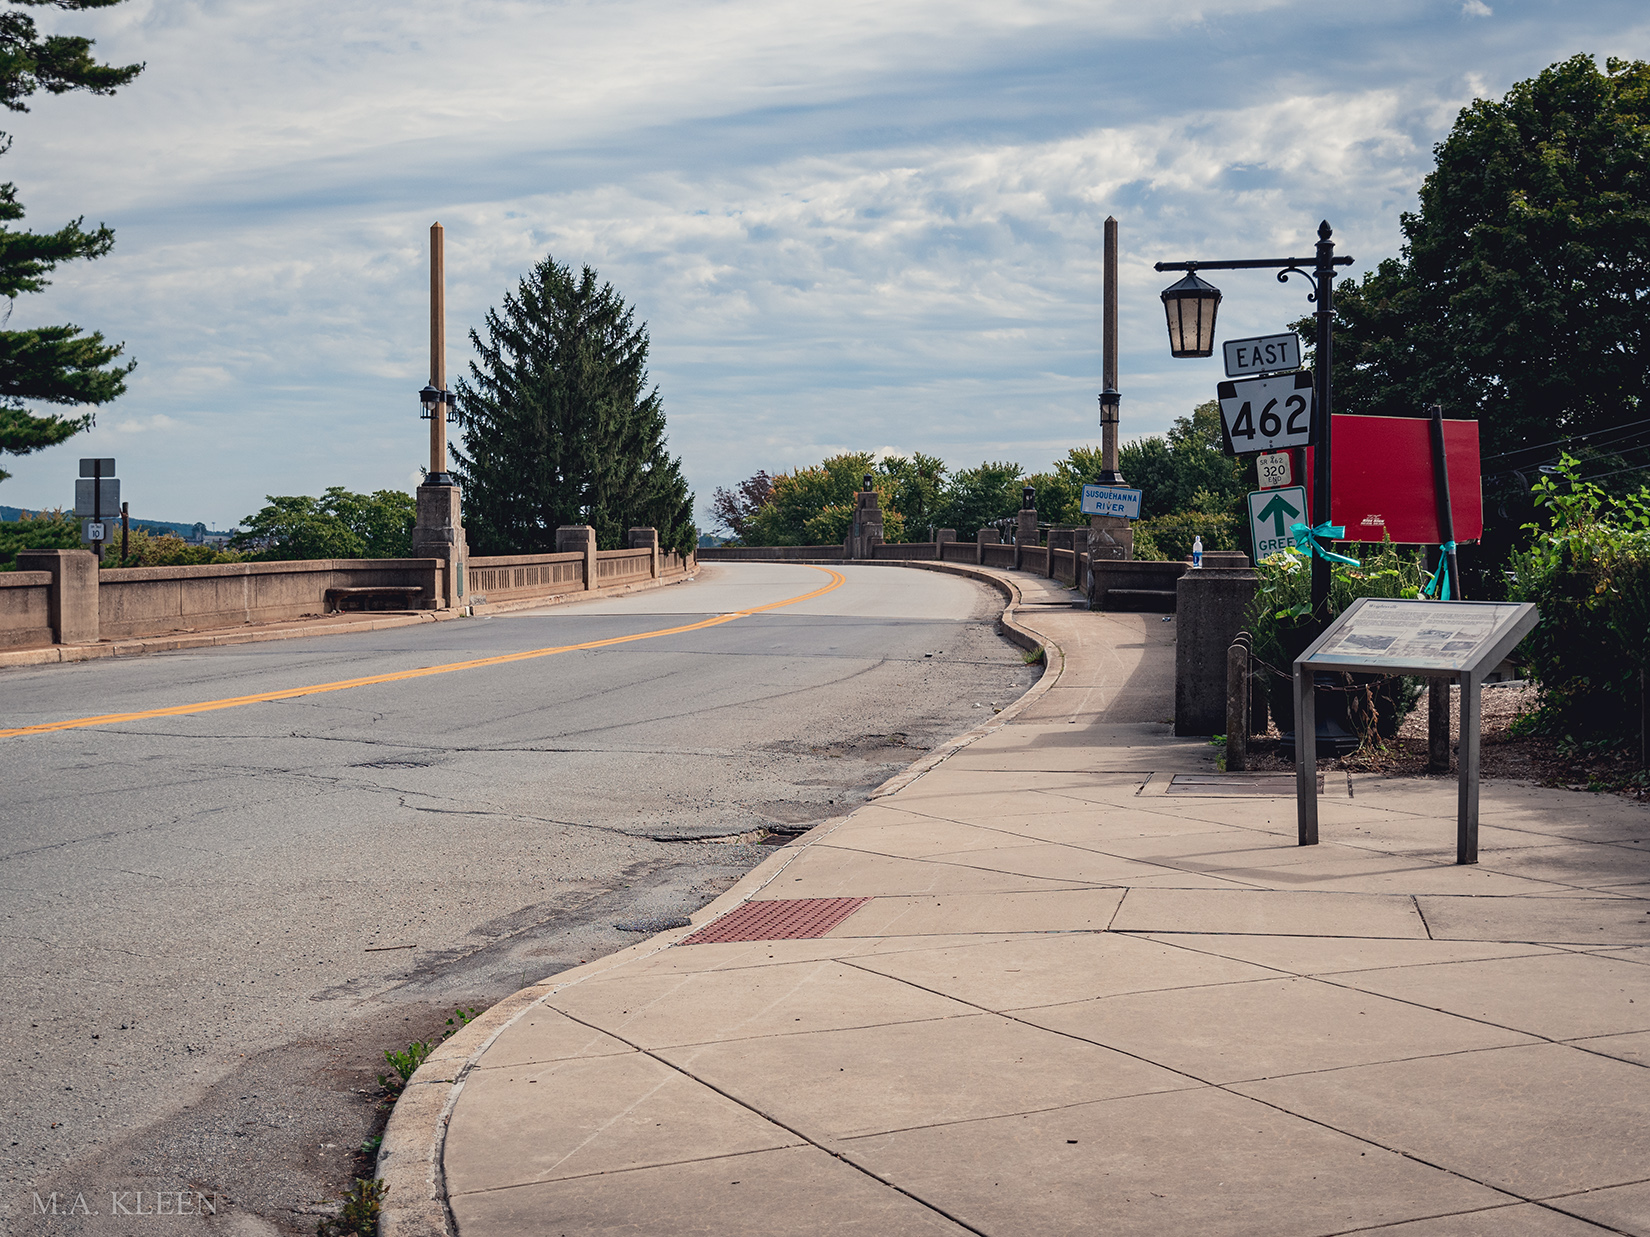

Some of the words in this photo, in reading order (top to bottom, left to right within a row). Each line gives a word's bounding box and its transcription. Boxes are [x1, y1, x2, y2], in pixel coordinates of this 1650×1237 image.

[1236, 342, 1288, 368] EAST
[1231, 395, 1308, 440] 462
[1263, 465, 1286, 477] 320
[1086, 490, 1137, 502] SUSQUEHANNA
[1096, 502, 1125, 512] RIVER
[1259, 538, 1296, 550] GREE
